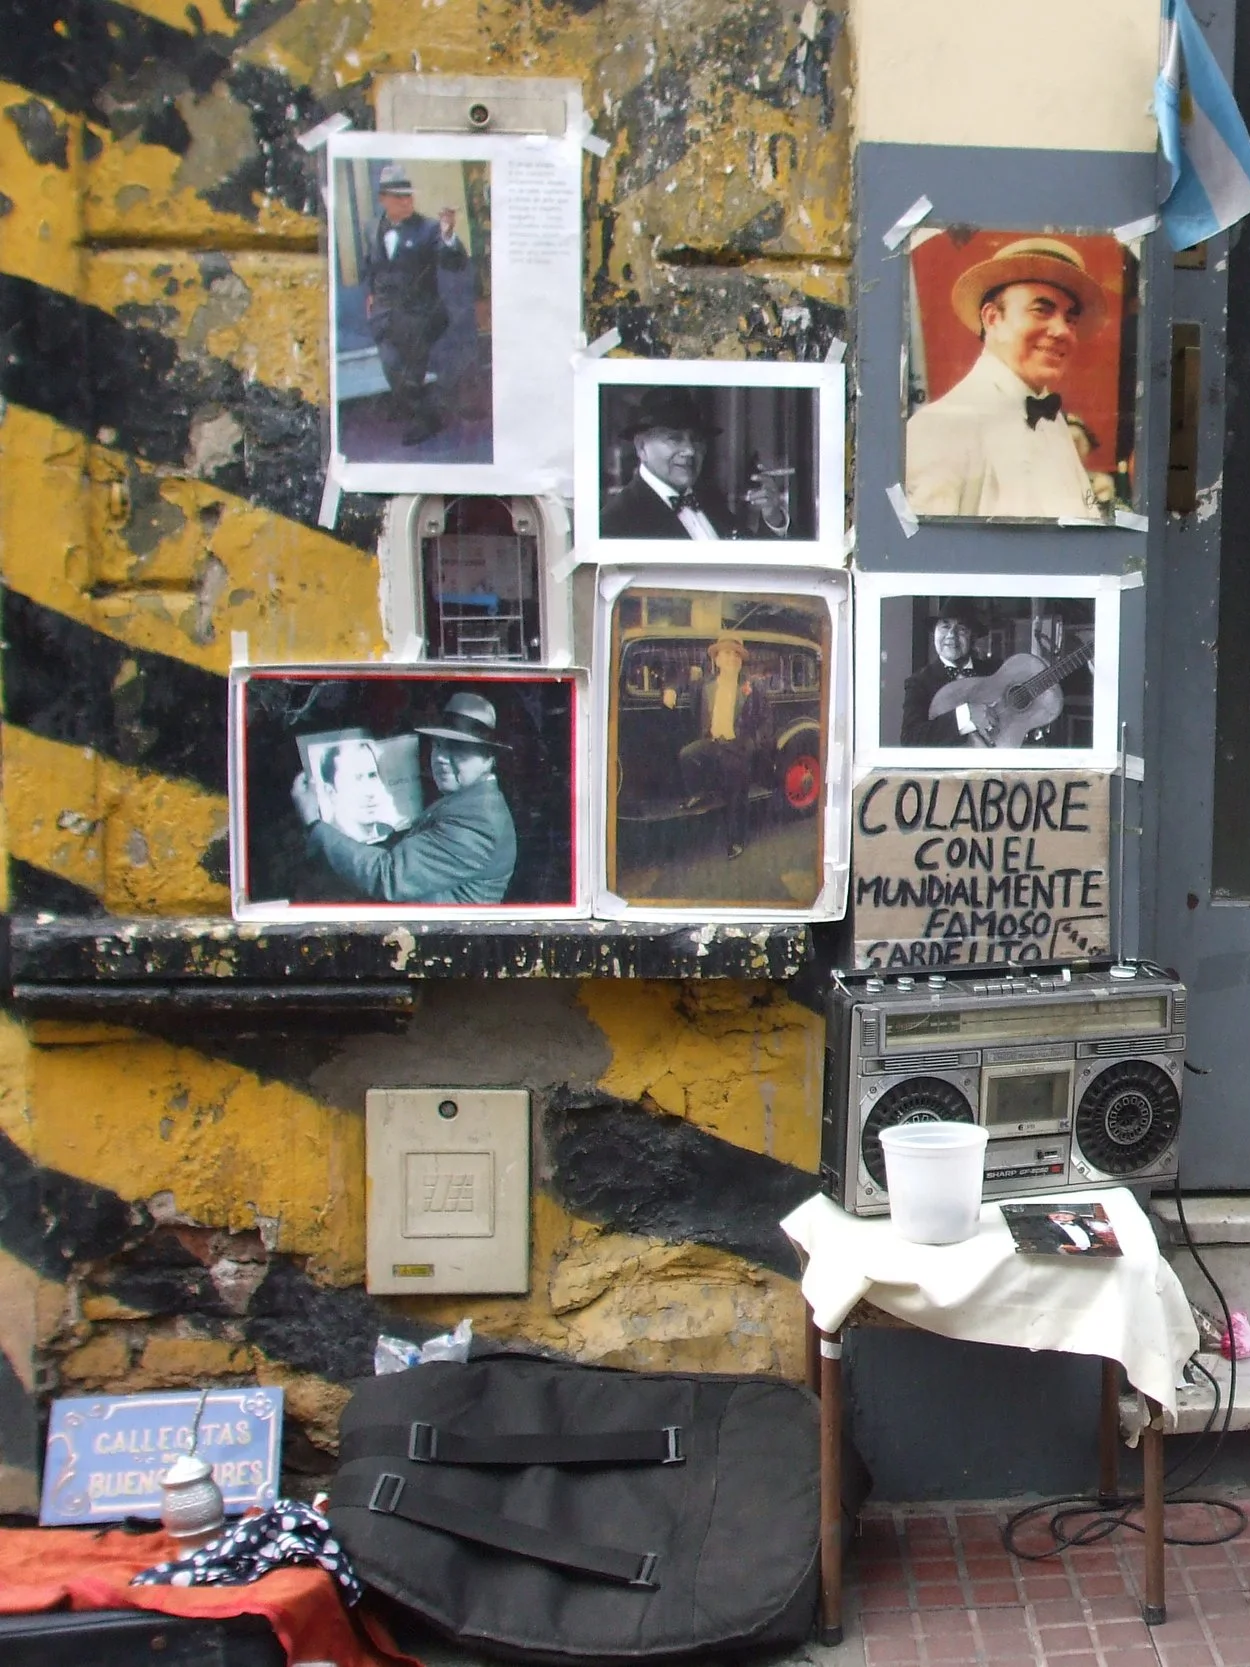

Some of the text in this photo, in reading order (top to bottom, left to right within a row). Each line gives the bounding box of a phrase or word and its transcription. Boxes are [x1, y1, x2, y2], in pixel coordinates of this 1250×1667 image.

[858, 776, 1092, 837] COLABORE
[914, 836, 1045, 873] CON EL
[924, 908, 1051, 939] FAMOSO
[986, 1169, 1017, 1179] SHARP
